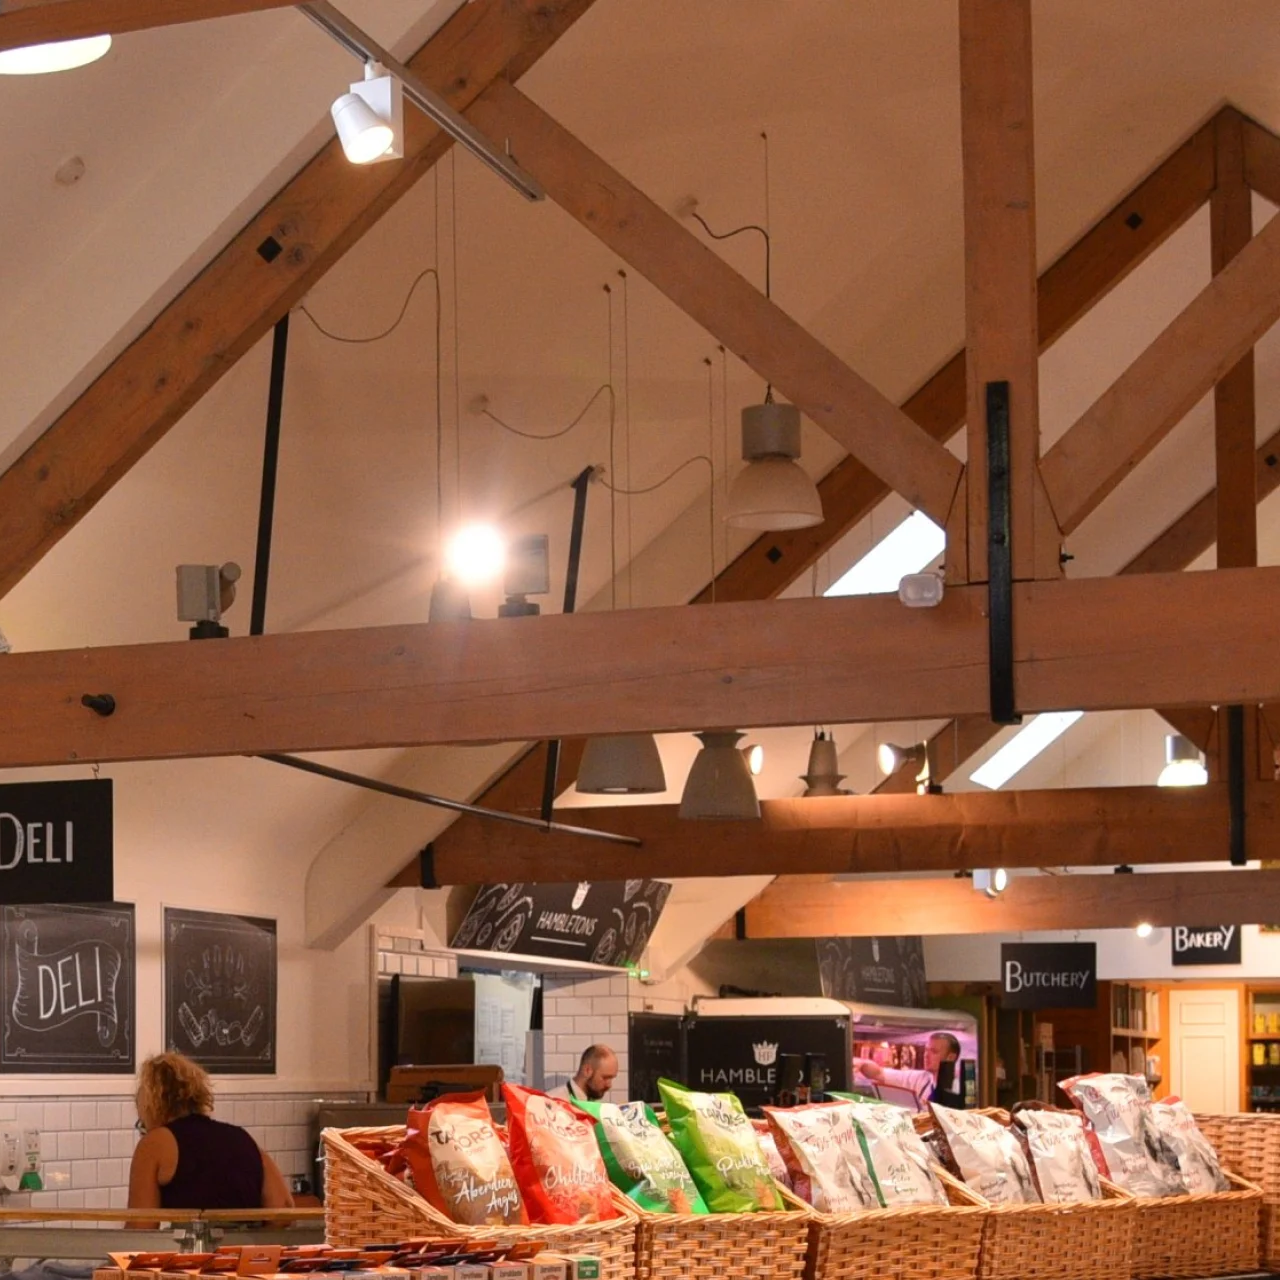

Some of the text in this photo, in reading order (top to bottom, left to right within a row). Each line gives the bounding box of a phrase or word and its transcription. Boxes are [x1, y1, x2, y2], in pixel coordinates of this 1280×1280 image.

[536, 911, 599, 936] HAMBLETONS
[1175, 924, 1234, 951] BAKERY
[37, 946, 102, 1020] DELI
[1005, 960, 1091, 992] BUTCHERY
